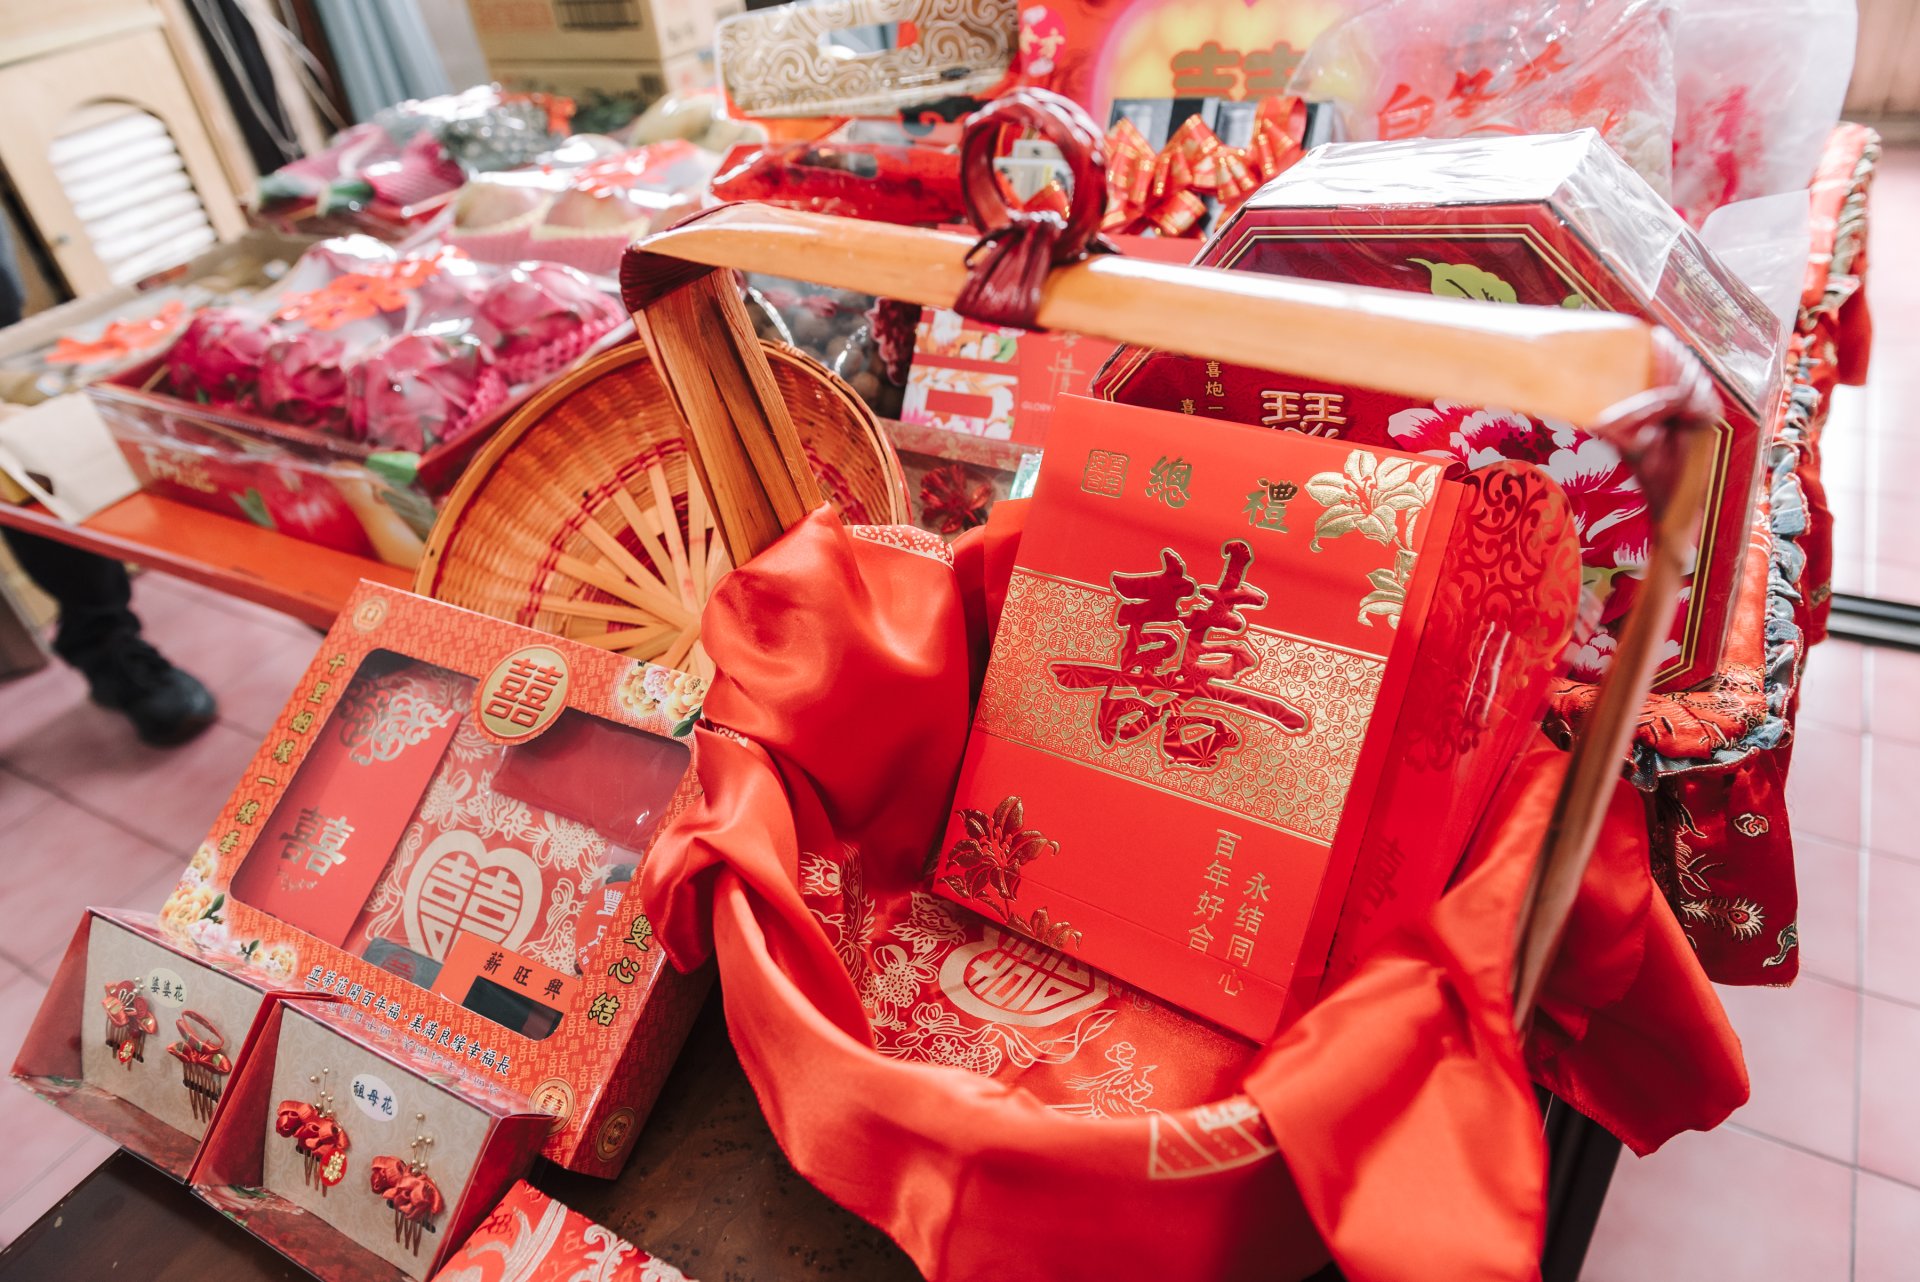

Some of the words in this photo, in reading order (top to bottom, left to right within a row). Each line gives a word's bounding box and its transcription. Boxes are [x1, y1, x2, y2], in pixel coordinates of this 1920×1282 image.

[484, 658, 564, 728] 囍
[1187, 828, 1243, 955] 百年好合
[1217, 871, 1272, 997] 永结同心
[150, 975, 184, 1003] 婆婆花
[483, 950, 565, 1001] 薪旺興
[588, 914, 654, 1027] 雙心結
[353, 1080, 394, 1117] 祖母花
